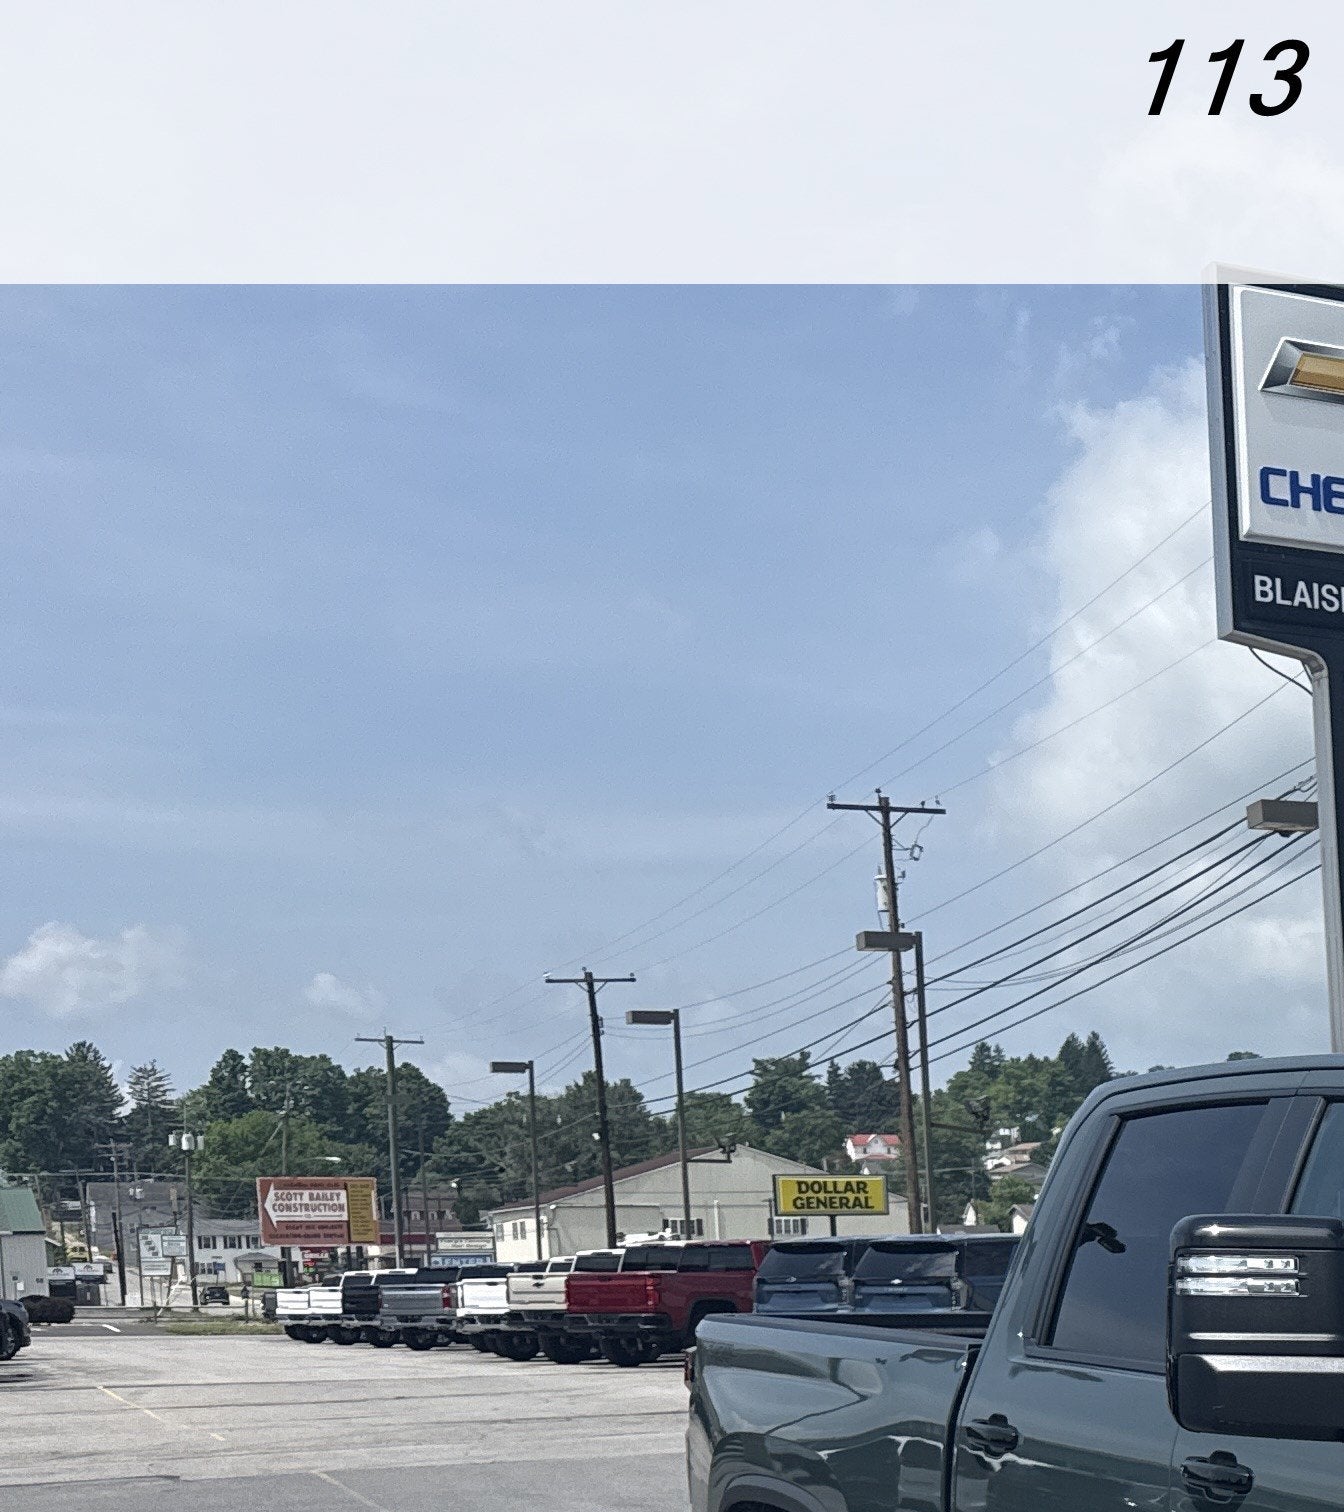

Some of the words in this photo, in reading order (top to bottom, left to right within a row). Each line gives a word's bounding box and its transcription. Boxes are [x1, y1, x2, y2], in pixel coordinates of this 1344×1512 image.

[796, 1180, 869, 1195] DOLLAR
[273, 1191, 305, 1201] SCOTT
[308, 1191, 341, 1201] BAILEY
[792, 1195, 875, 1210] GENERAL
[271, 1202, 346, 1213] CONSTRUCTION
